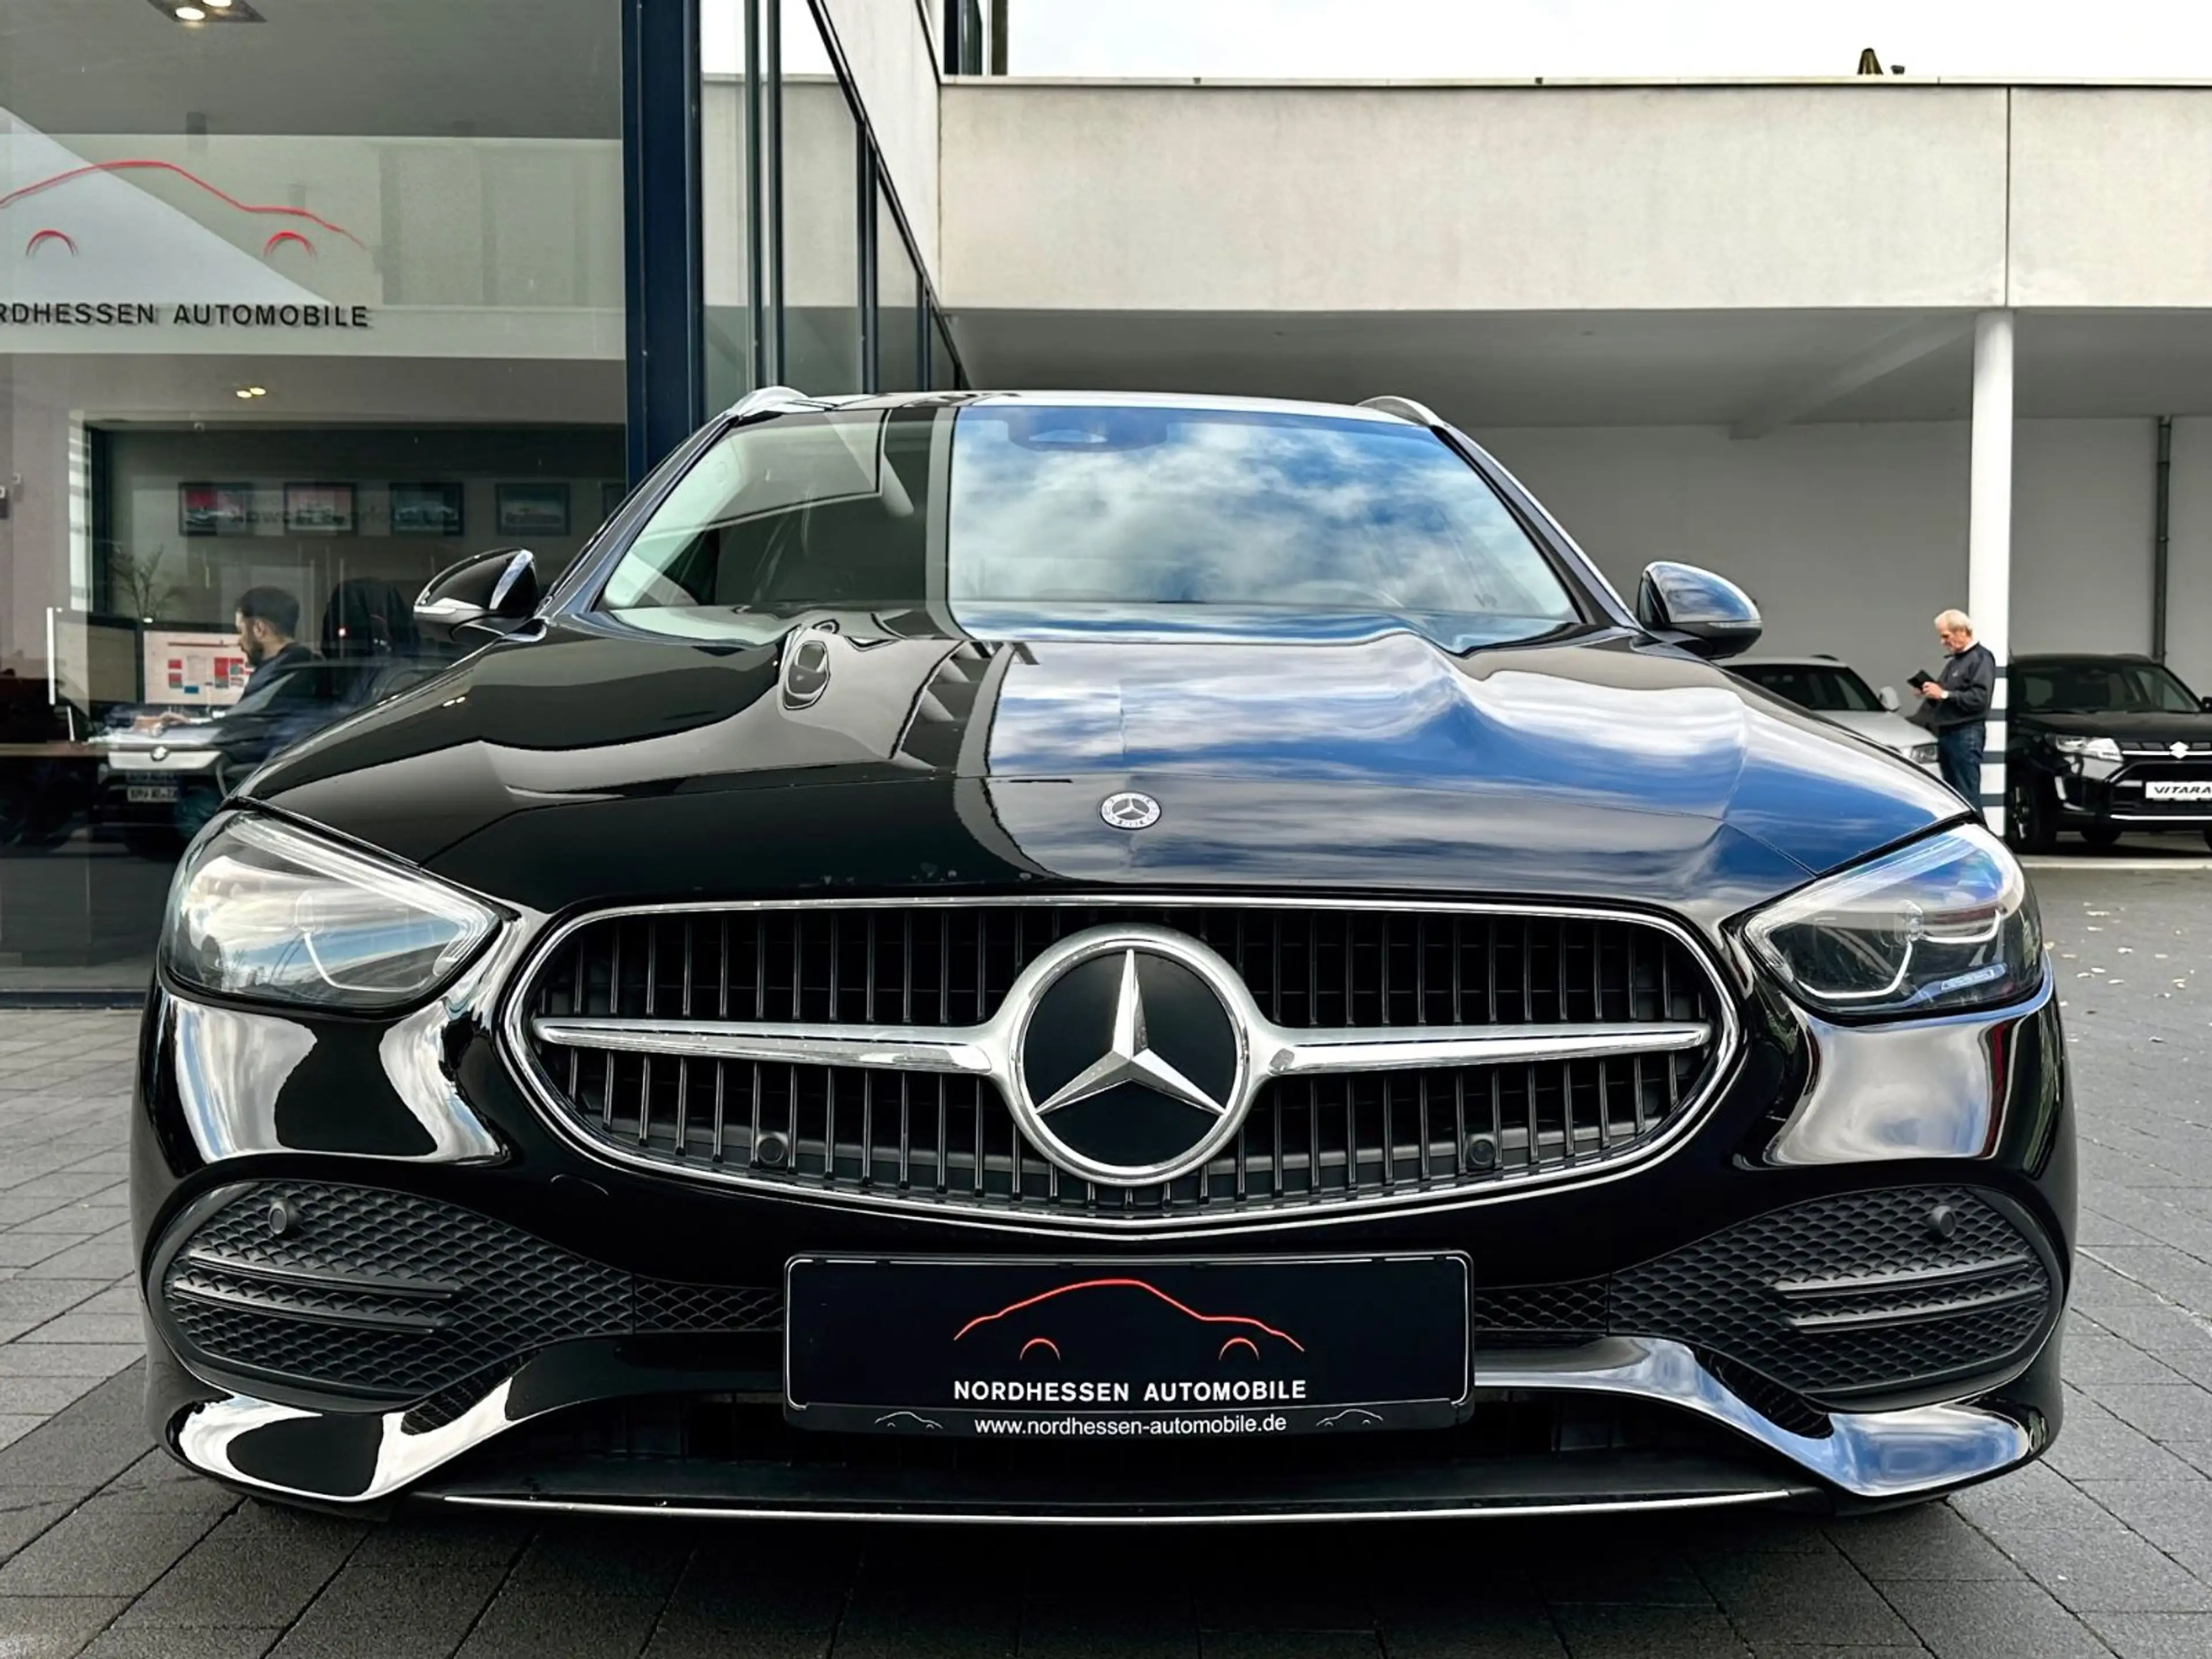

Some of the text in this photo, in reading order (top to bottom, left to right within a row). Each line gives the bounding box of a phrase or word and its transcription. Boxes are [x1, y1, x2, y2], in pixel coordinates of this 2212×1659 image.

[173, 304, 368, 327] AUTOMOBILE
[2153, 786, 2211, 794] VITARA
[954, 1380, 1306, 1402] NORDHESSEN AUTOMOBILE
[974, 1413, 1287, 1435] www.nordhessen-automobile.de
